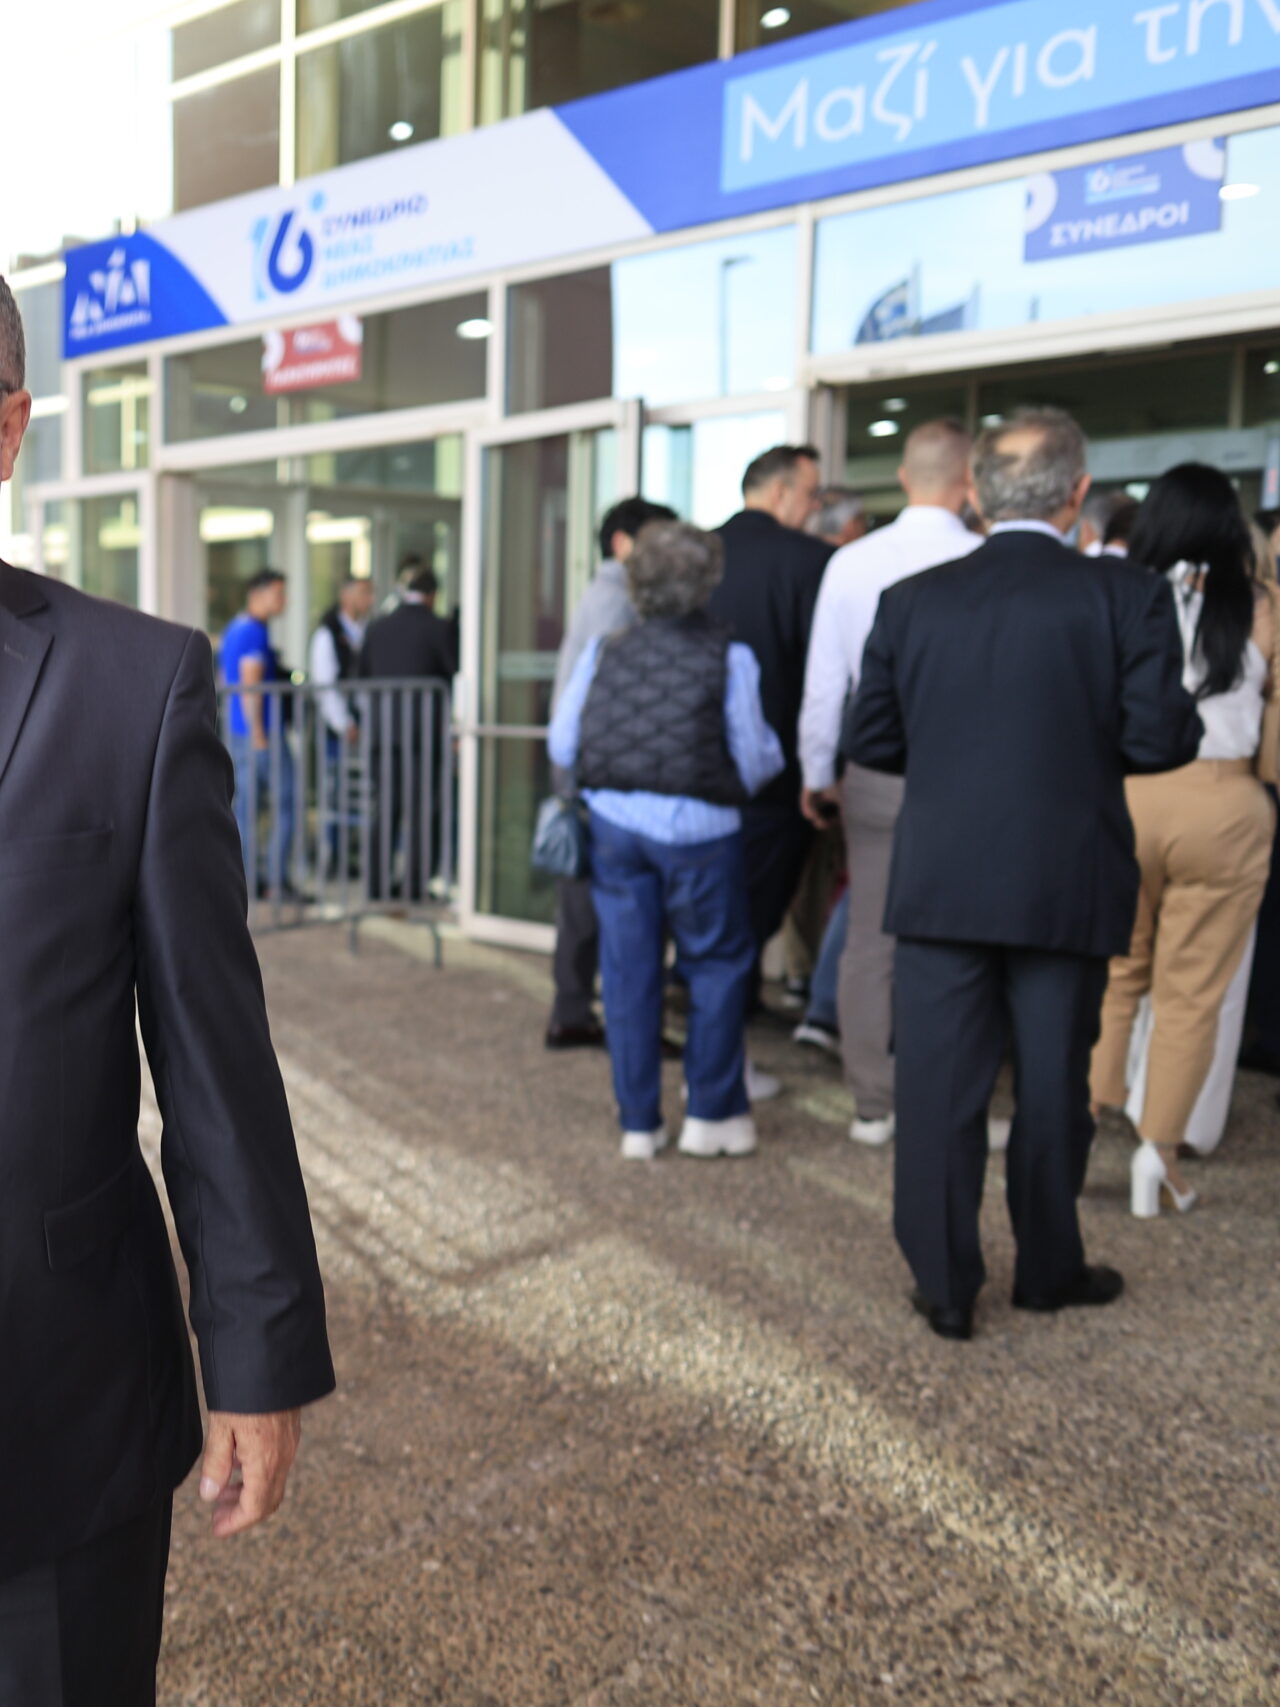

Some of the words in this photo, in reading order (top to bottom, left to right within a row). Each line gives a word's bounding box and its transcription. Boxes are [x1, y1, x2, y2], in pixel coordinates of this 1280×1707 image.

[739, 40, 937, 163] Μαζί
[961, 24, 1098, 128] για
[1050, 201, 1190, 246] ΣΥΝΕΔΡΟΙ
